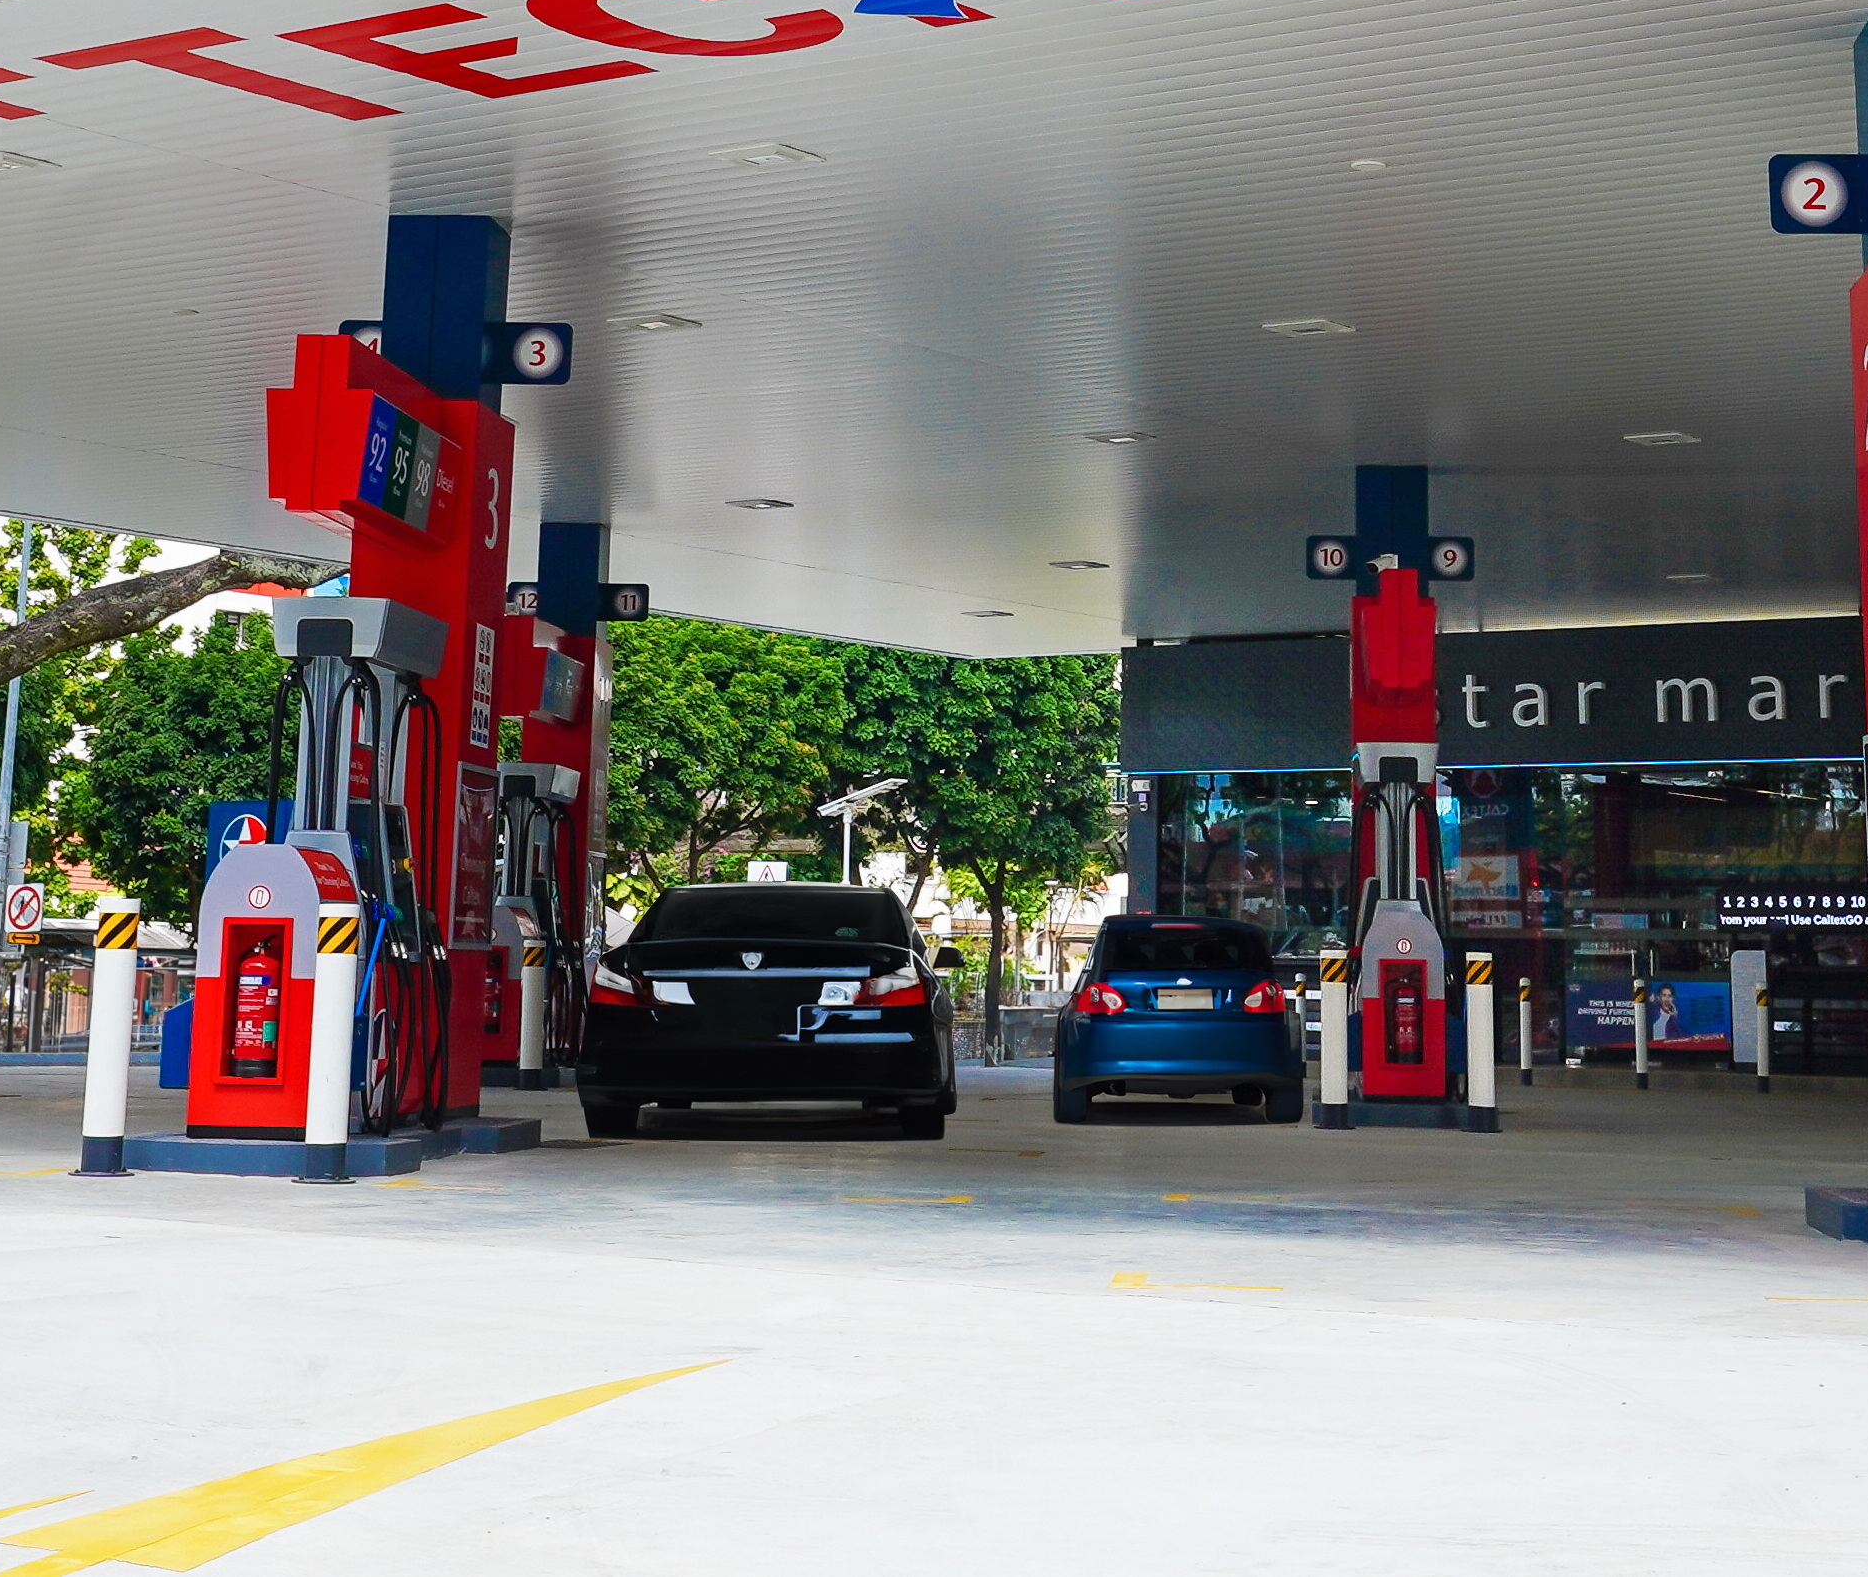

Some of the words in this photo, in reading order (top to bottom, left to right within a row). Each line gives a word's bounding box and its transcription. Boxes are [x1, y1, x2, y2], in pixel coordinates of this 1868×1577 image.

[1802, 178, 1827, 210] 2
[529, 341, 546, 366] 3
[369, 433, 387, 473] 92
[392, 446, 410, 484] 95
[415, 460, 431, 497] 98
[436, 468, 454, 494] Diesel
[484, 468, 500, 550] 3
[1320, 549, 1344, 566] 10
[1443, 550, 1457, 567] 9
[519, 593, 538, 609] 12
[621, 594, 638, 611] 11
[1435, 674, 1606, 728] tar
[1723, 896, 1731, 908] 1
[1736, 896, 1745, 908] 2
[1750, 896, 1759, 908] 3
[1764, 896, 1773, 908] 4
[1779, 896, 1787, 908] 5
[1793, 896, 1802, 908] 6
[1807, 896, 1816, 908] 7
[1822, 896, 1831, 908] 8
[1836, 896, 1845, 908] 9
[1850, 896, 1866, 908] 10
[1743, 917, 1767, 927] your
[1791, 915, 1811, 925] Use
[1813, 914, 1863, 925] CaltexGO
